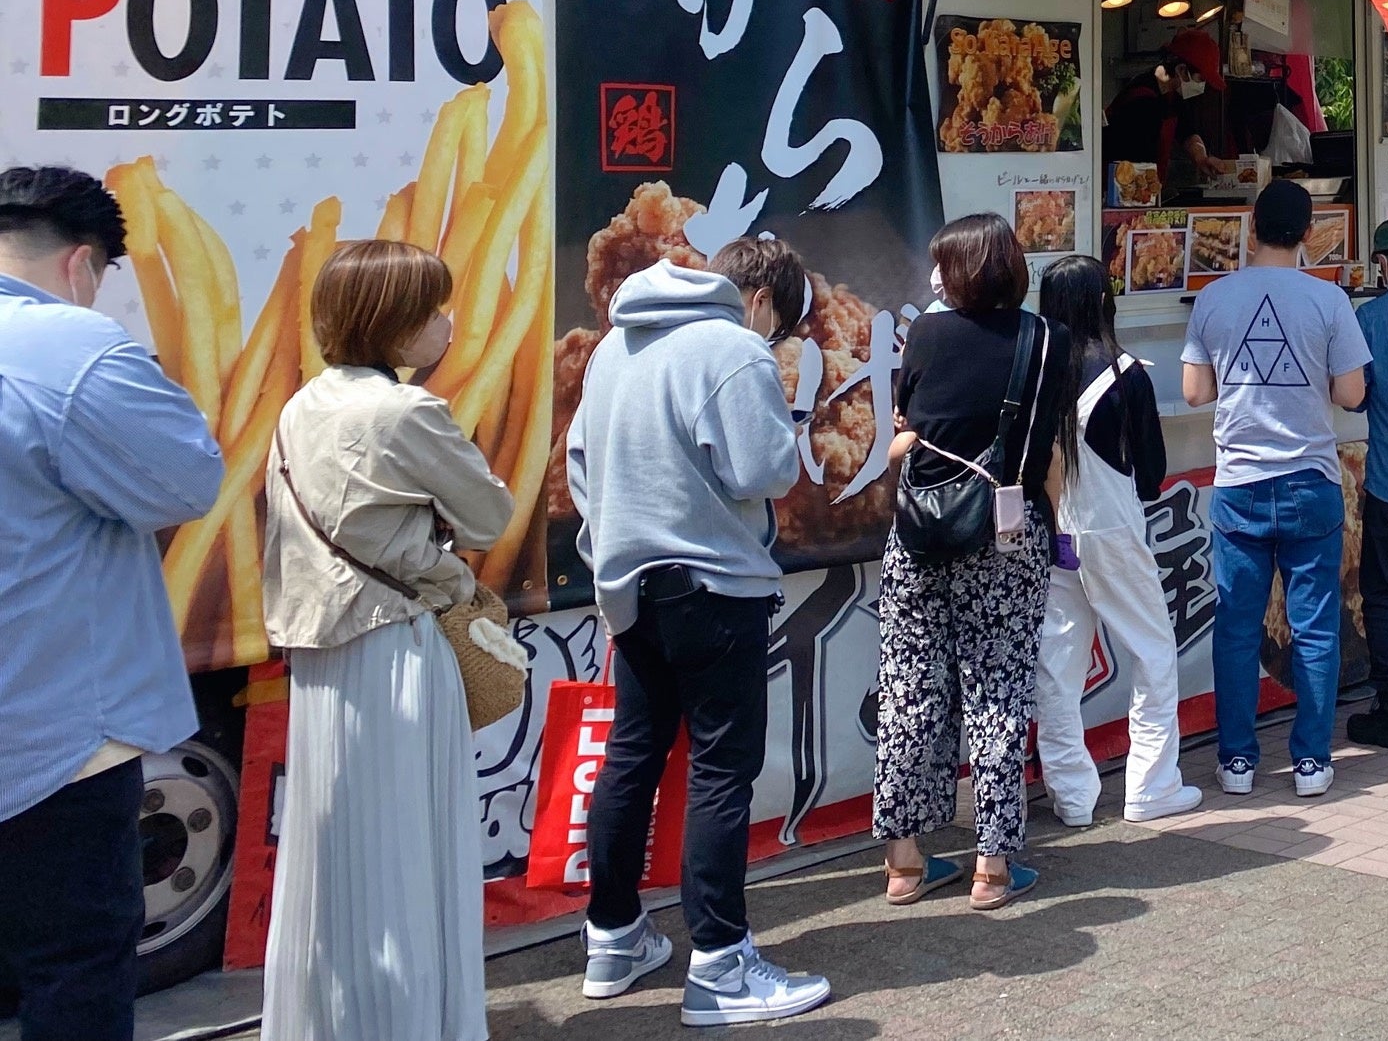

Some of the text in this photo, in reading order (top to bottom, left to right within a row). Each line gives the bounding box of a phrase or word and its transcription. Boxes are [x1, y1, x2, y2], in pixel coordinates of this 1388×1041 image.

[107, 103, 287, 127] ロングポテト
